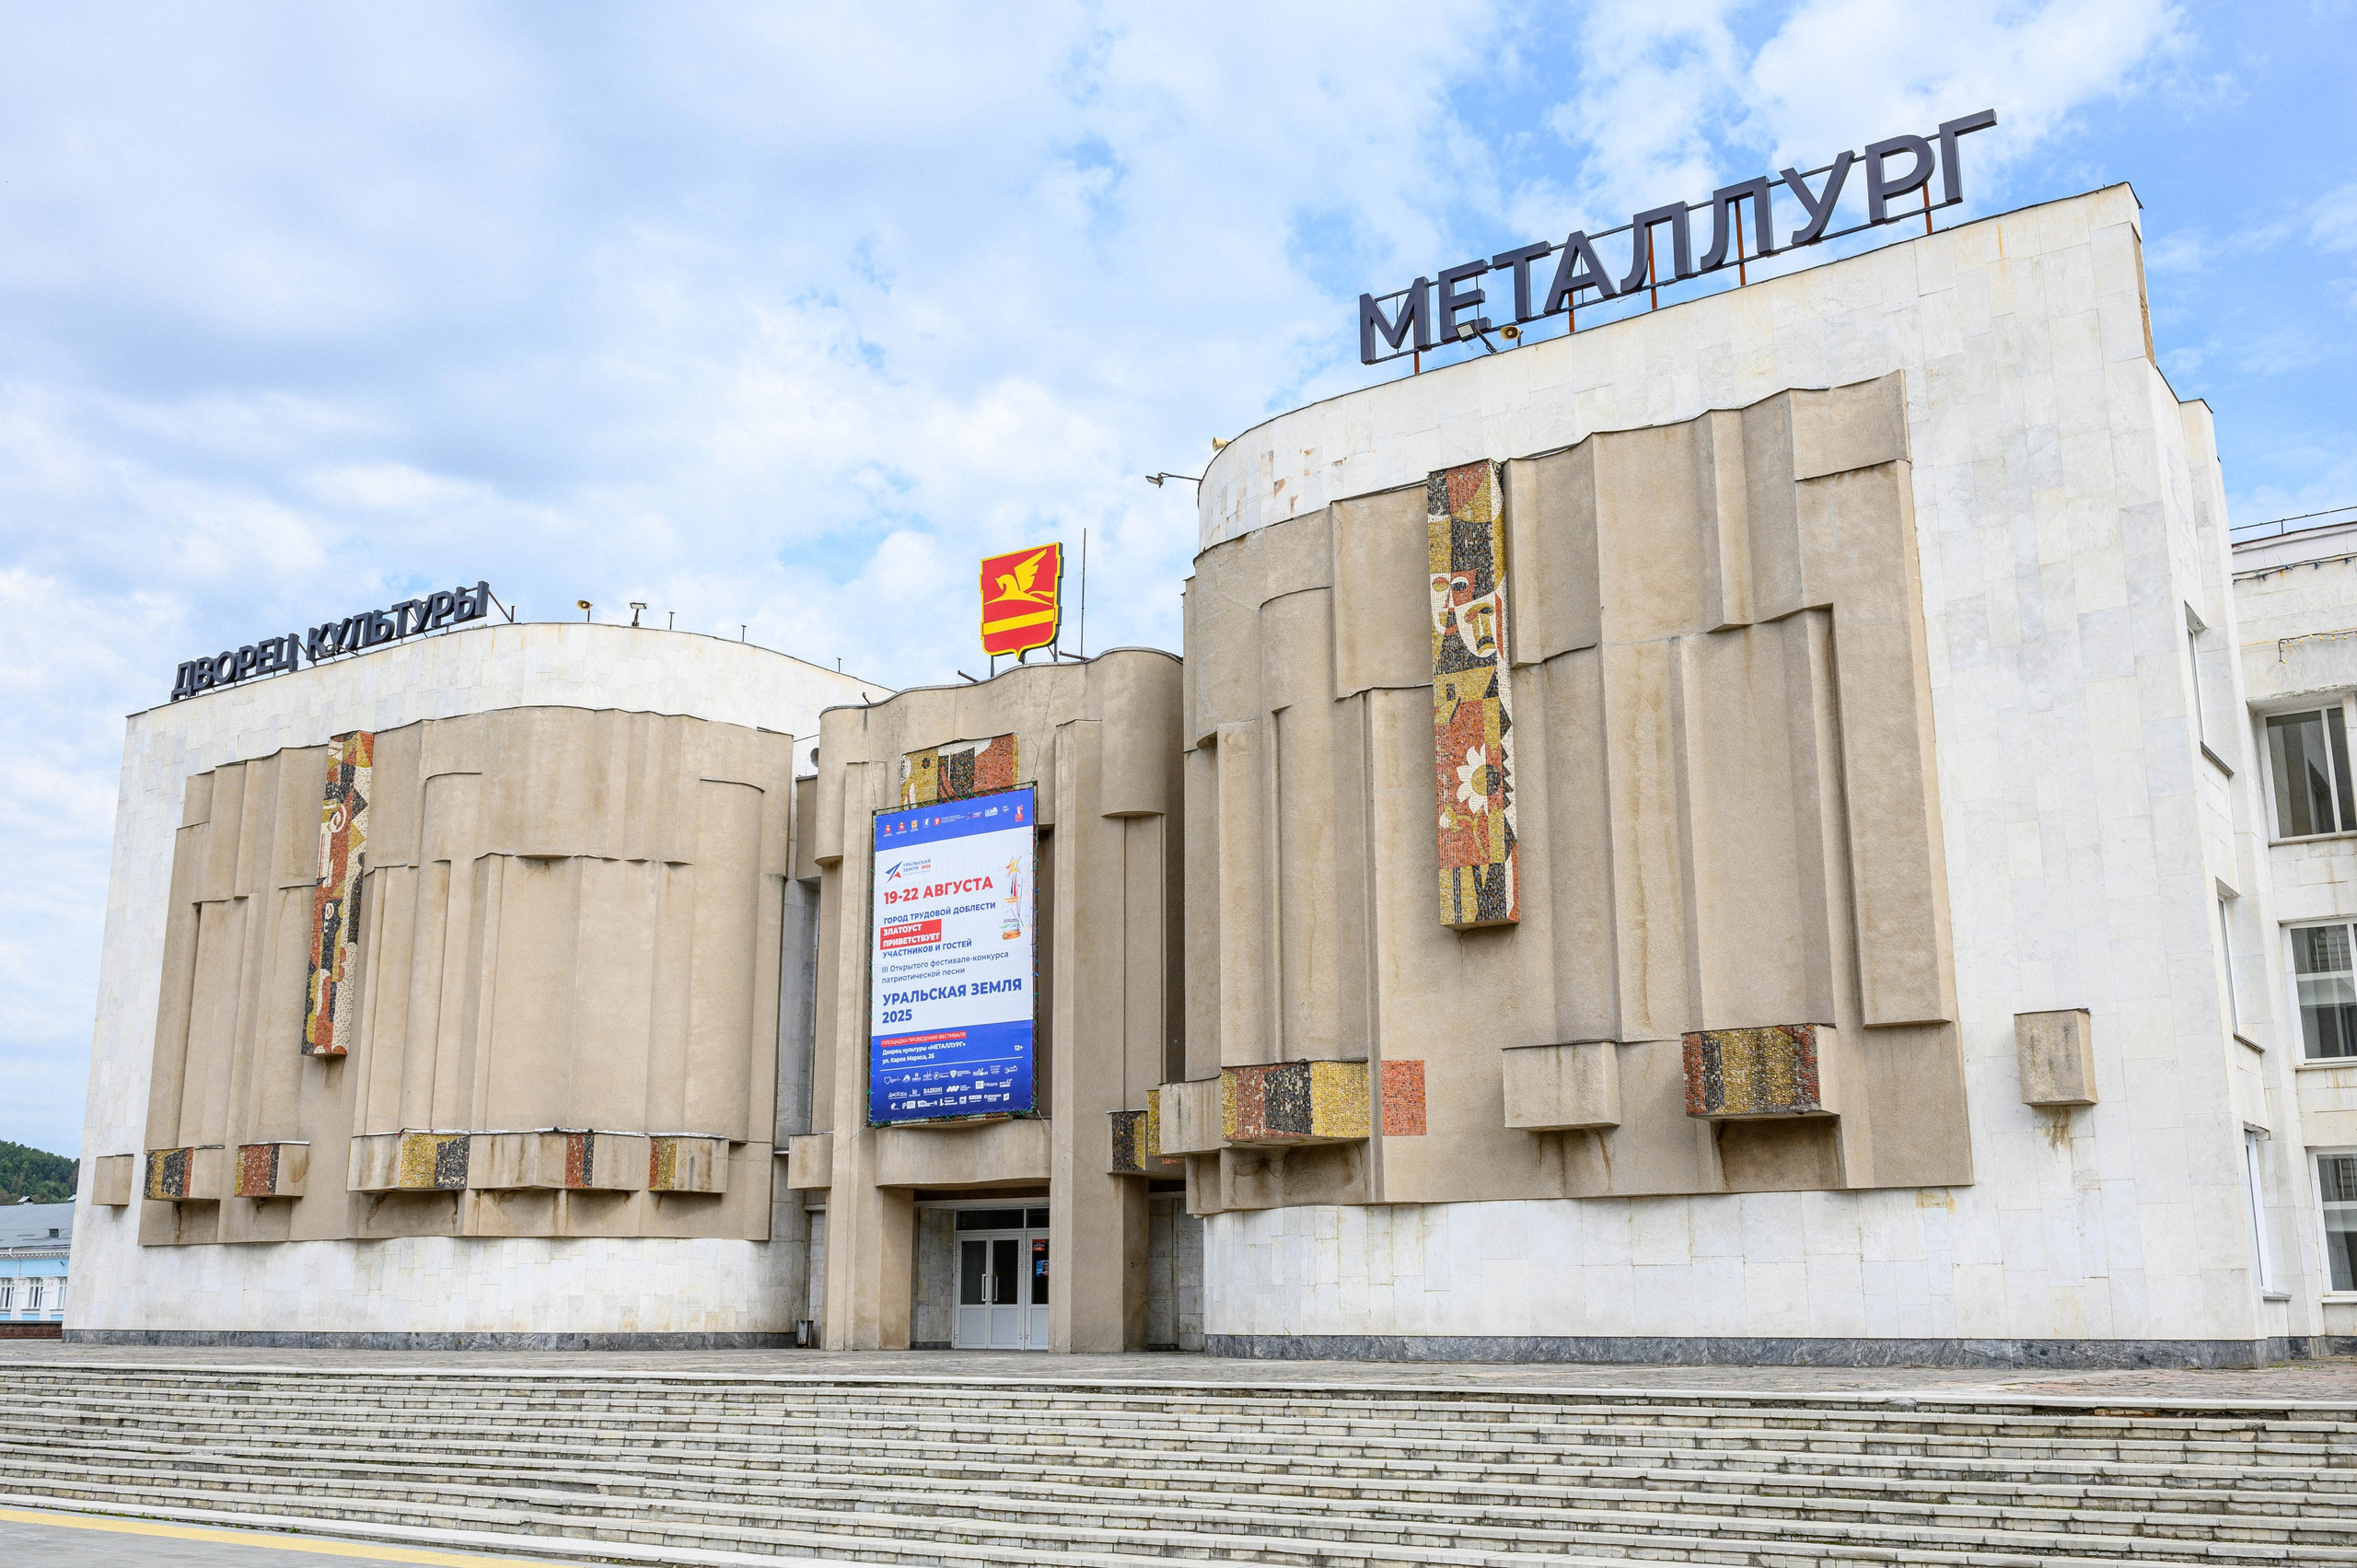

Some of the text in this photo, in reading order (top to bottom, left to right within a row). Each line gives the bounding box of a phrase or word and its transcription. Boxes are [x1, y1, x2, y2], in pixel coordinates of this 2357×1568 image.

[1360, 109, 1996, 365] МЕТАЛЛУРГ
[170, 581, 489, 702] ДВОРЕЦ КУЛЬТУРЫ
[884, 877, 993, 905] 19-22 АВГУСТА
[883, 901, 996, 924] ГОРОД ТРУДОВОЙ ДОБЛЕСТИ
[883, 923, 923, 936] ЗЛАТОУСТ
[883, 932, 940, 947] ПРИВЕТСТВУЕТ
[882, 945, 934, 959] УЧАСТНИКОВ
[942, 938, 972, 950] ГОСТЕЙ
[889, 961, 928, 973] Открытого
[930, 951, 1009, 968] фестиваля-конкурса
[882, 968, 966, 984] патриотической песни
[883, 978, 1022, 1006] УРАЛЬСКАЯ ЗЕМЛЯ
[882, 1008, 912, 1024] 2025
[881, 1032, 966, 1046] ПЛОЩАДКА ПРОВЕДЕНИЯ ФЕСТИВАЛЯ
[902, 1046, 927, 1054] культуры
[927, 1041, 966, 1051] «МЕТАЛЛУРГ»
